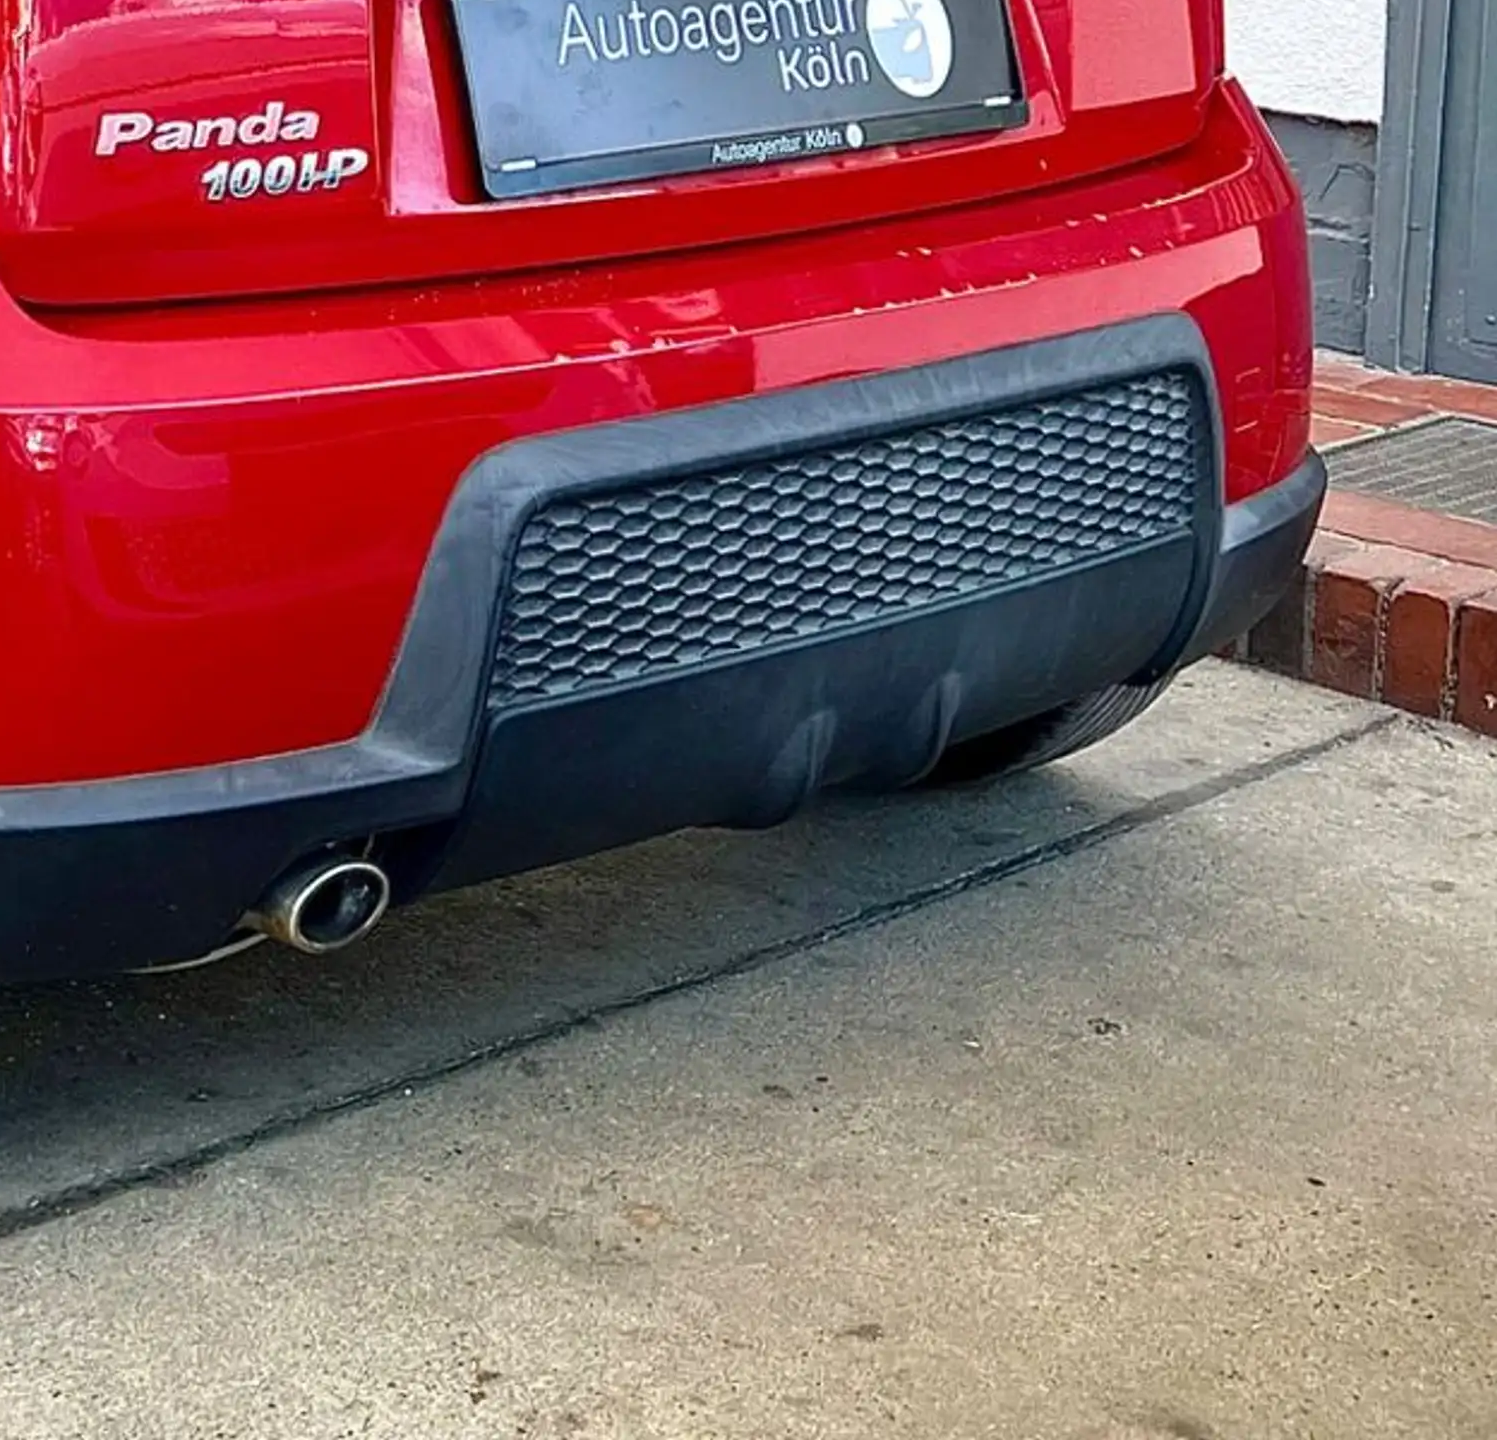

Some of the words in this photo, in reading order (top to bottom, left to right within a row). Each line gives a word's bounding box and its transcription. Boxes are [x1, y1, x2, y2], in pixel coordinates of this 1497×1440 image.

[778, 42, 869, 92] Köln
[95, 101, 320, 157] Panda
[712, 135, 802, 164] Autoagentur
[805, 127, 844, 150] Köln
